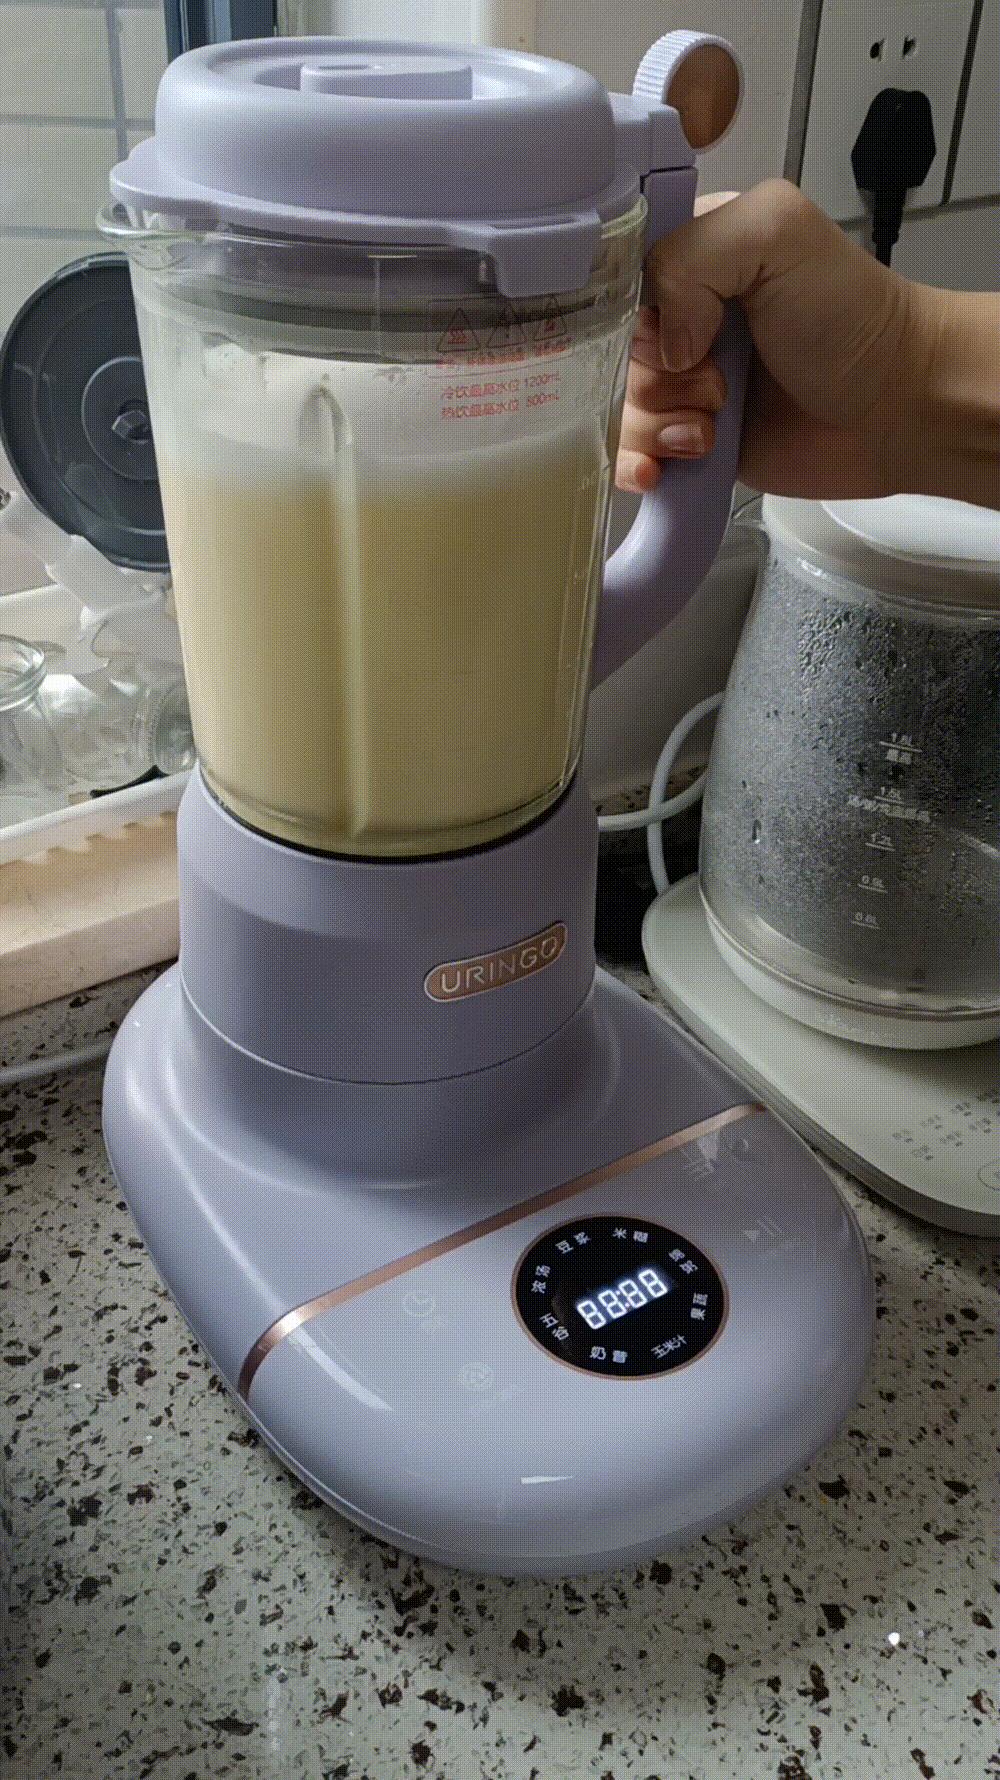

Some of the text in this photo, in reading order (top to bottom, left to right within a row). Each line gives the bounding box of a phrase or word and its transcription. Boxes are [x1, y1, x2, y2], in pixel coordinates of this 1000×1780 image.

[442, 936, 557, 992] URINGO
[555, 1231, 591, 1254] 豆浆
[612, 1227, 649, 1243] 米糊
[530, 1264, 551, 1294] 浓汤
[690, 1292, 708, 1321] 果蔬
[539, 1312, 570, 1341] 五谷
[589, 1346, 628, 1364] 奶昔
[650, 1334, 688, 1359] 玉米汁
